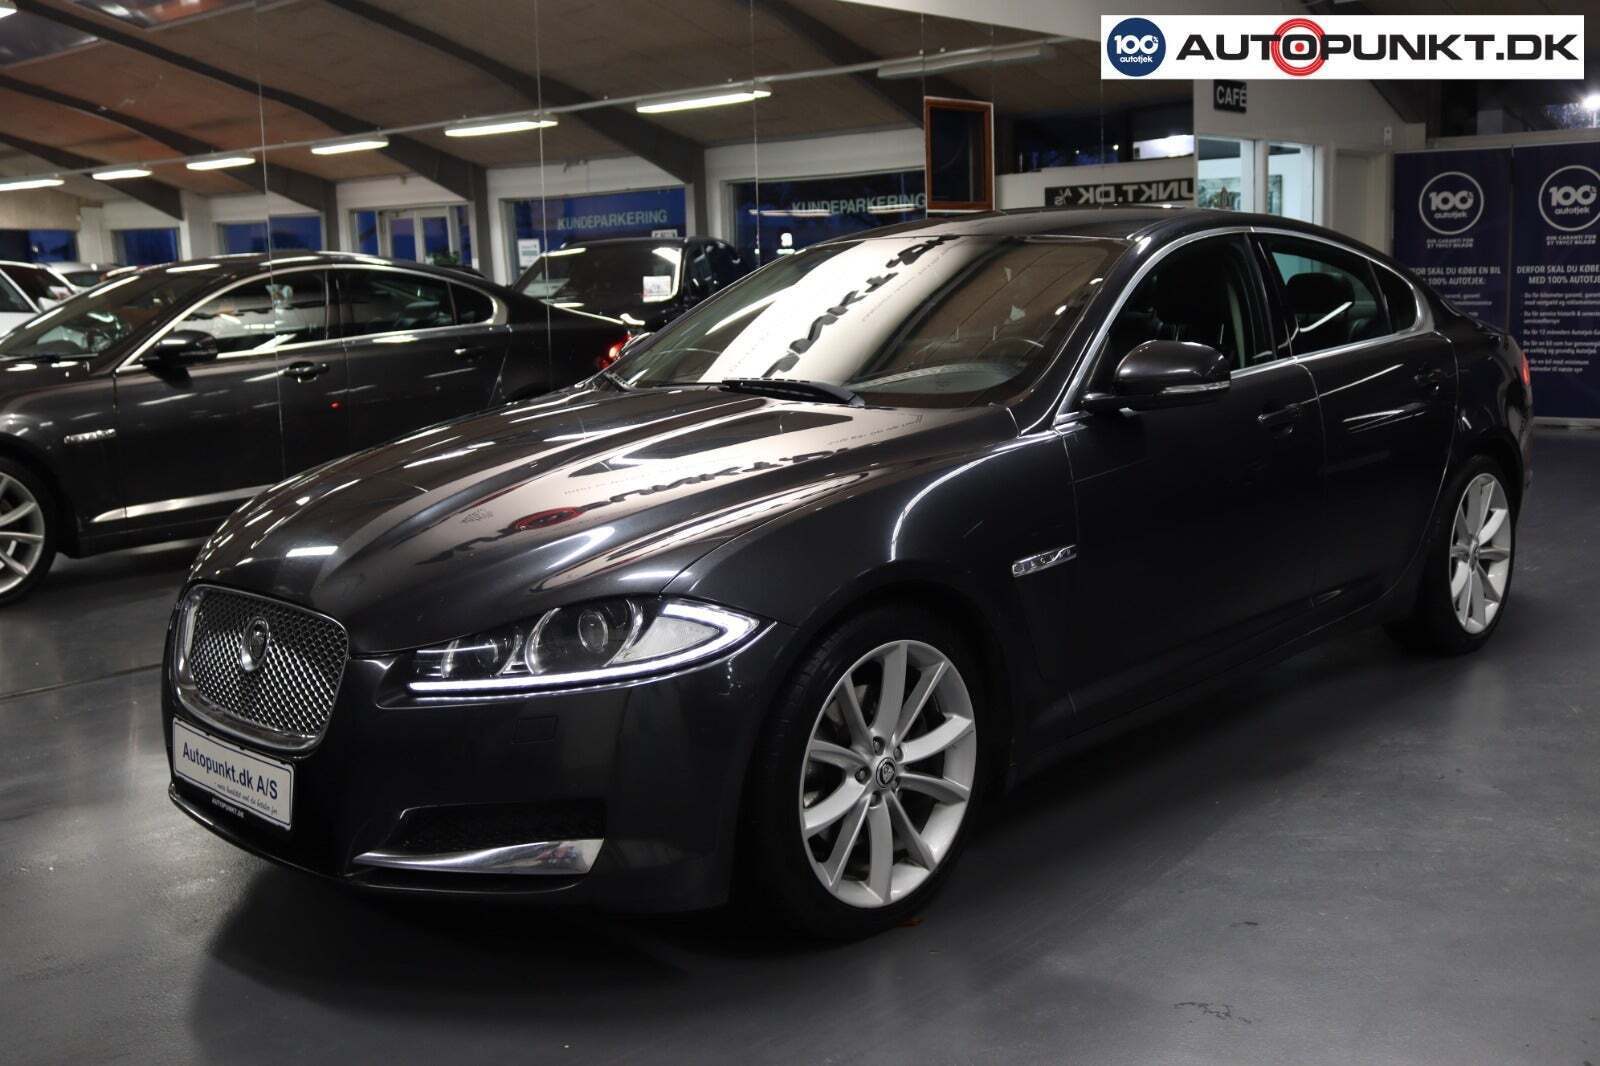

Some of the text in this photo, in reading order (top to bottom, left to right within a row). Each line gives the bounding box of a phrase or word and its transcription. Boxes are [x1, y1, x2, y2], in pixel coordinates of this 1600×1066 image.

[1216, 85, 1248, 108] CAFÉ
[791, 192, 927, 216] KUNDEPARKERING
[557, 208, 668, 231] KUNDEPARKERING
[1427, 267, 1444, 275] SKAL
[1516, 265, 1546, 274] DERFOR
[1547, 265, 1565, 273] SKAL
[1566, 265, 1577, 273] DU
[1528, 276, 1546, 284] MED
[1548, 276, 1568, 284] 100%
[182, 741, 254, 791] Autopunkt.dk
[256, 774, 278, 801] A/S
